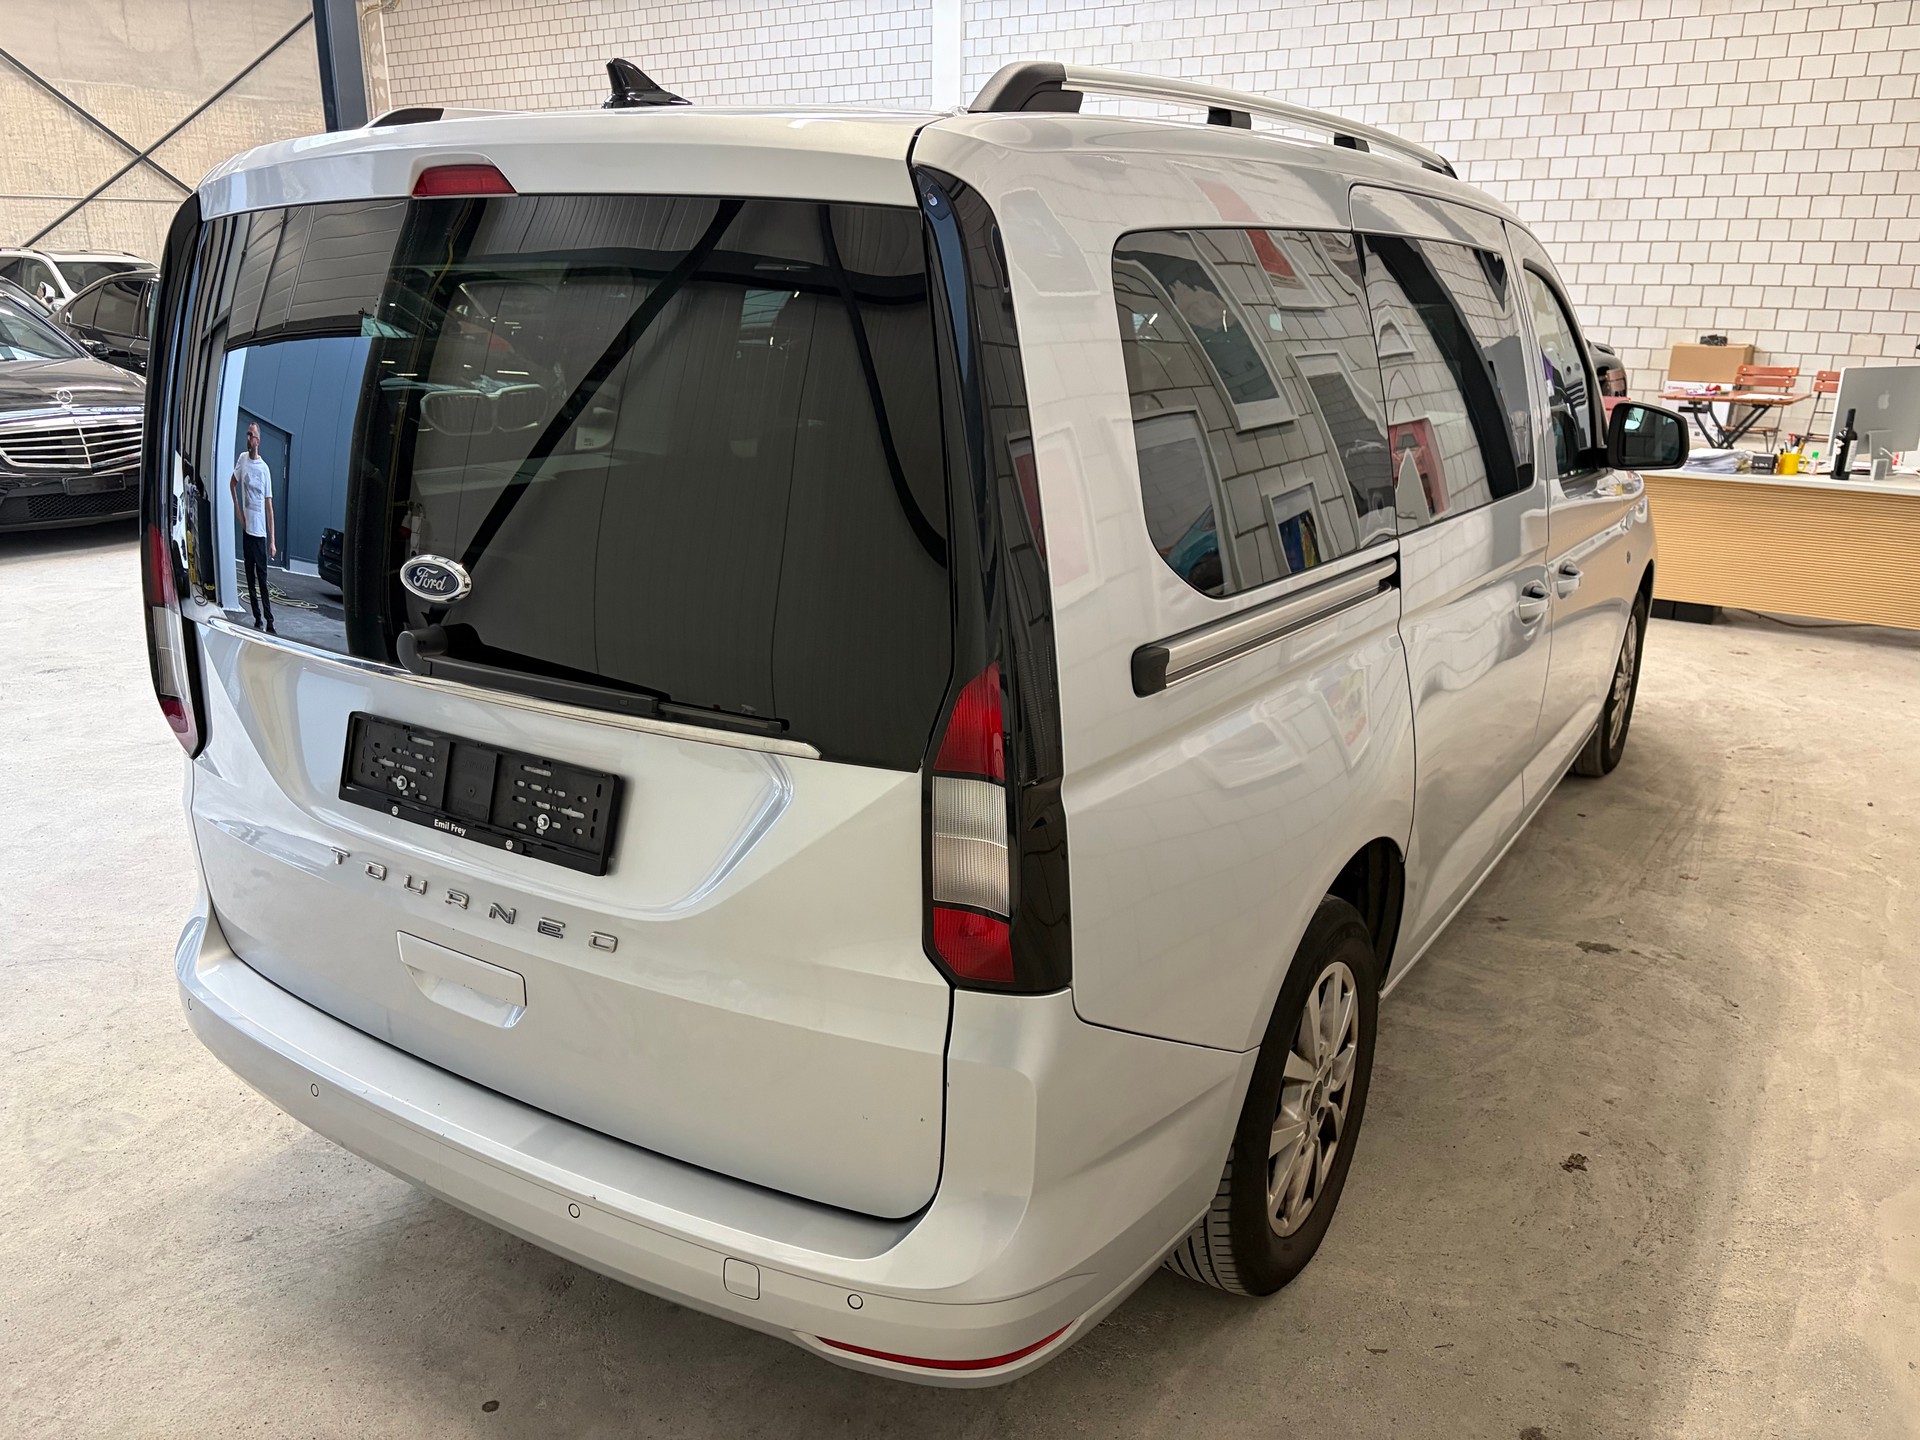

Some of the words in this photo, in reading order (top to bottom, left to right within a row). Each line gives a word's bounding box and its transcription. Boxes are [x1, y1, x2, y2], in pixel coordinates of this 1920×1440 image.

[413, 566, 447, 591] Ford
[433, 818, 450, 830] Emil
[450, 823, 467, 837] Frey
[329, 846, 619, 953] TOURNEO
